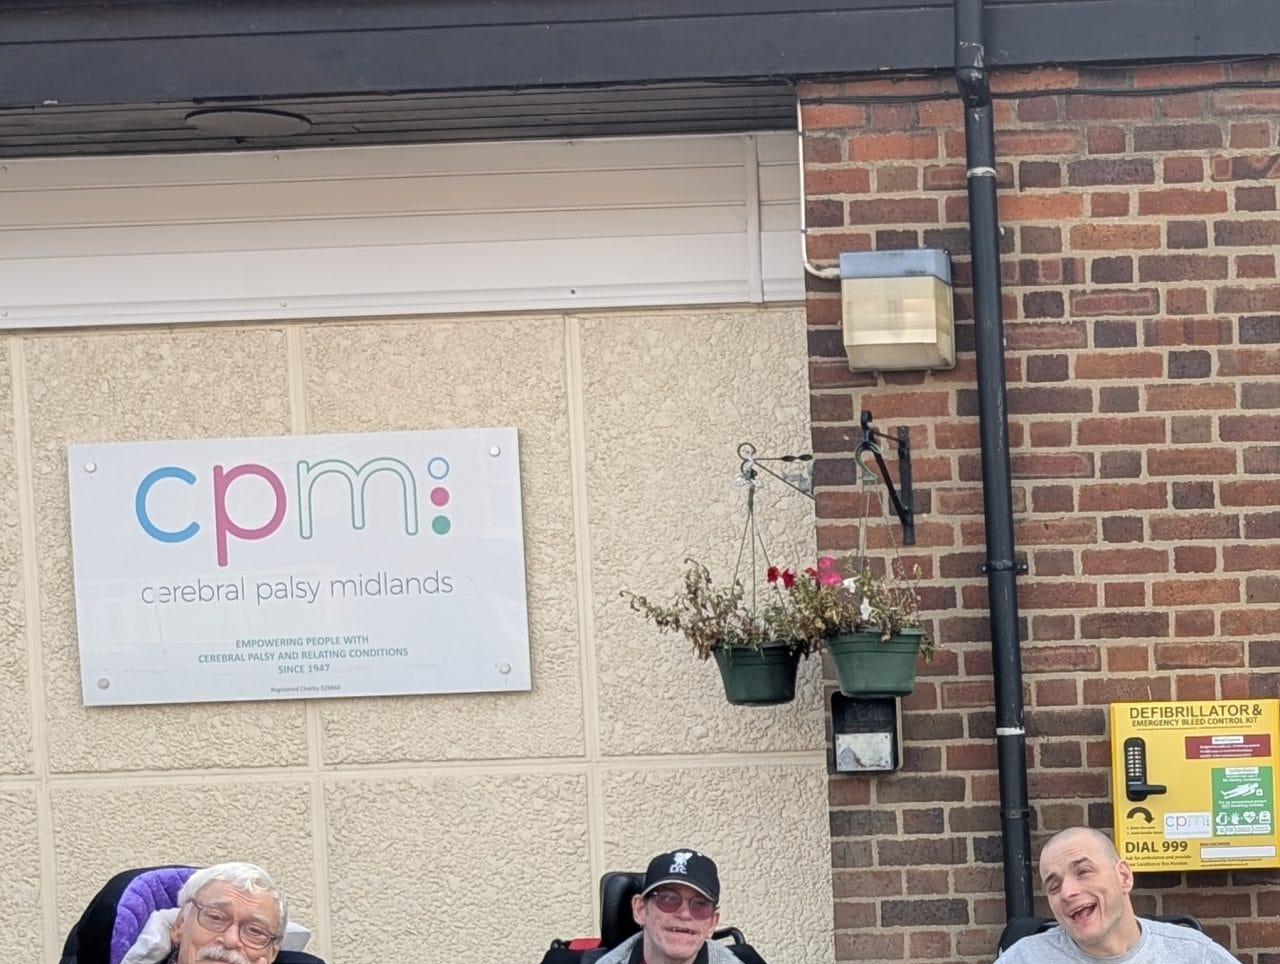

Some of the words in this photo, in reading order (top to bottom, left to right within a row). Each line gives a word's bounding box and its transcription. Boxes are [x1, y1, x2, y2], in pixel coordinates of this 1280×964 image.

[141, 577, 245, 604] cerebral
[256, 577, 321, 606] palsy
[330, 570, 454, 598] midlands
[235, 638, 304, 649] EMPOWERING
[306, 636, 341, 646] PEOPLE
[343, 635, 369, 645] WITH
[198, 654, 246, 663] CEREBRAL
[248, 653, 275, 662] PALSY
[278, 652, 299, 661] AND
[301, 650, 347, 660] RELATING
[349, 648, 409, 658] CONDITIONS
[278, 665, 305, 674] SINCE
[307, 664, 331, 673] 1947
[1129, 704, 1250, 719] DEFIBRILLATOR
[1252, 703, 1263, 716] &
[1132, 719, 1179, 728] EMERGENCY
[1181, 718, 1206, 726] BLEED
[1207, 717, 1244, 725] CONTROL
[1245, 716, 1259, 724] KIT
[1125, 841, 1159, 854] DIAL
[1162, 840, 1189, 853] 999
